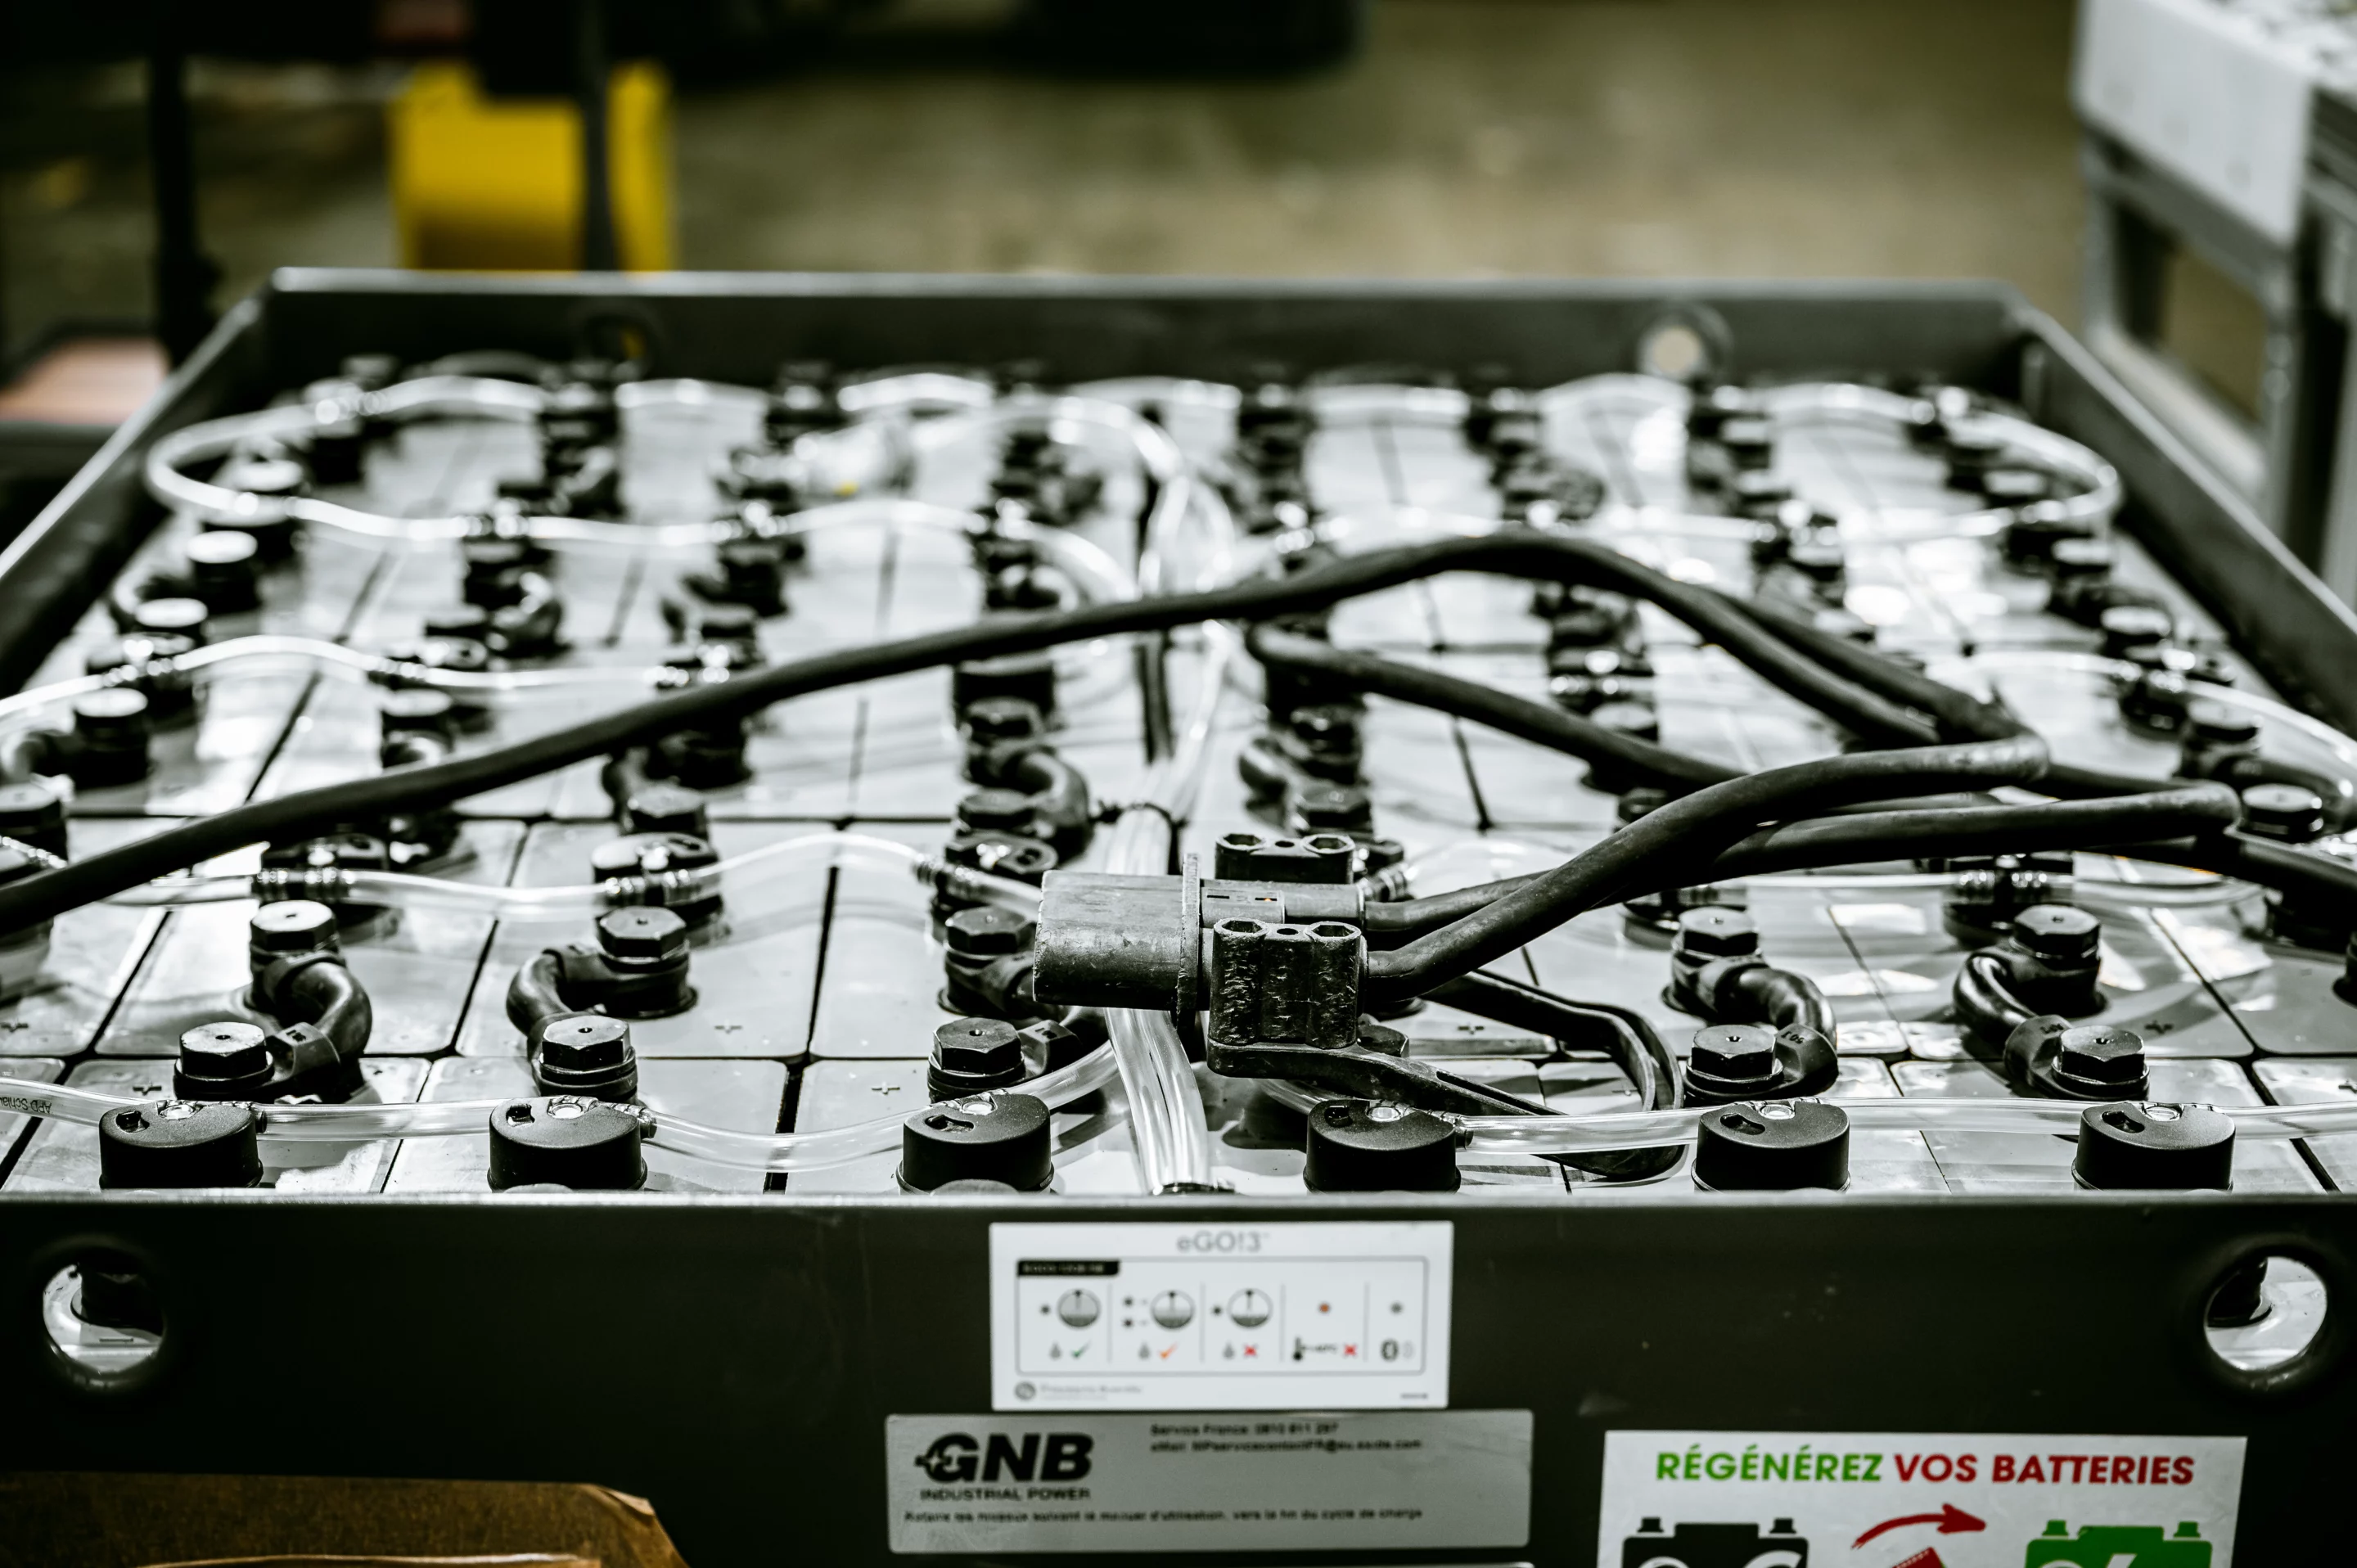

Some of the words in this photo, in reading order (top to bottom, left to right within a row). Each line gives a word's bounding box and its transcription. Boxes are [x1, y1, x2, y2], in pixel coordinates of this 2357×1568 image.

[914, 1432, 1095, 1484] GNB
[1656, 1444, 1883, 1482] RÉGÉNÉREZ
[1894, 1453, 1978, 1483] VOS
[1991, 1454, 2195, 1485] BATTERIES
[921, 1488, 1021, 1501] INDUSTRIAL
[1026, 1487, 1091, 1500] POWER
